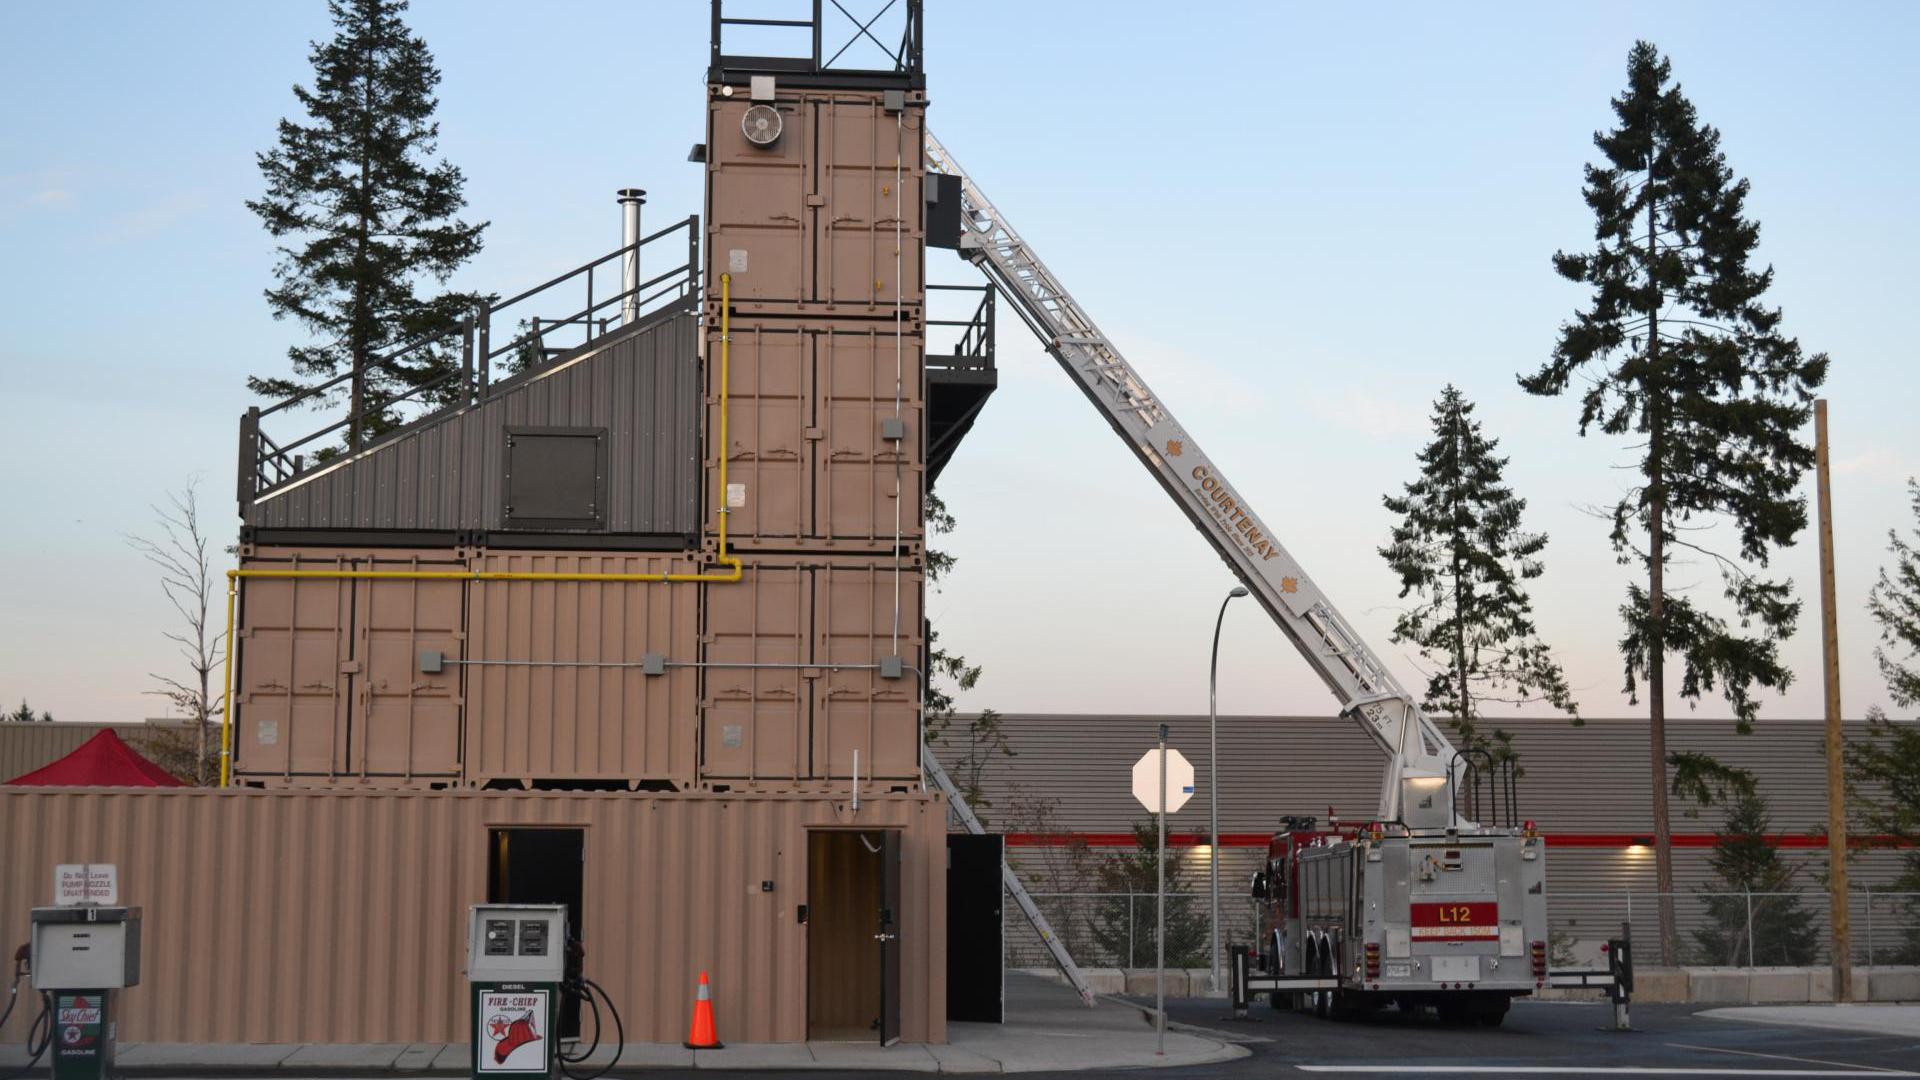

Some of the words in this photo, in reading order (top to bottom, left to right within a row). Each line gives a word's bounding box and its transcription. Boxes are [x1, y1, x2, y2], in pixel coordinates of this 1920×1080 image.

[1192, 466, 1279, 561] COURTENAY
[1366, 708, 1379, 722] 23
[90, 909, 95, 920] 1
[1440, 906, 1471, 922] L12
